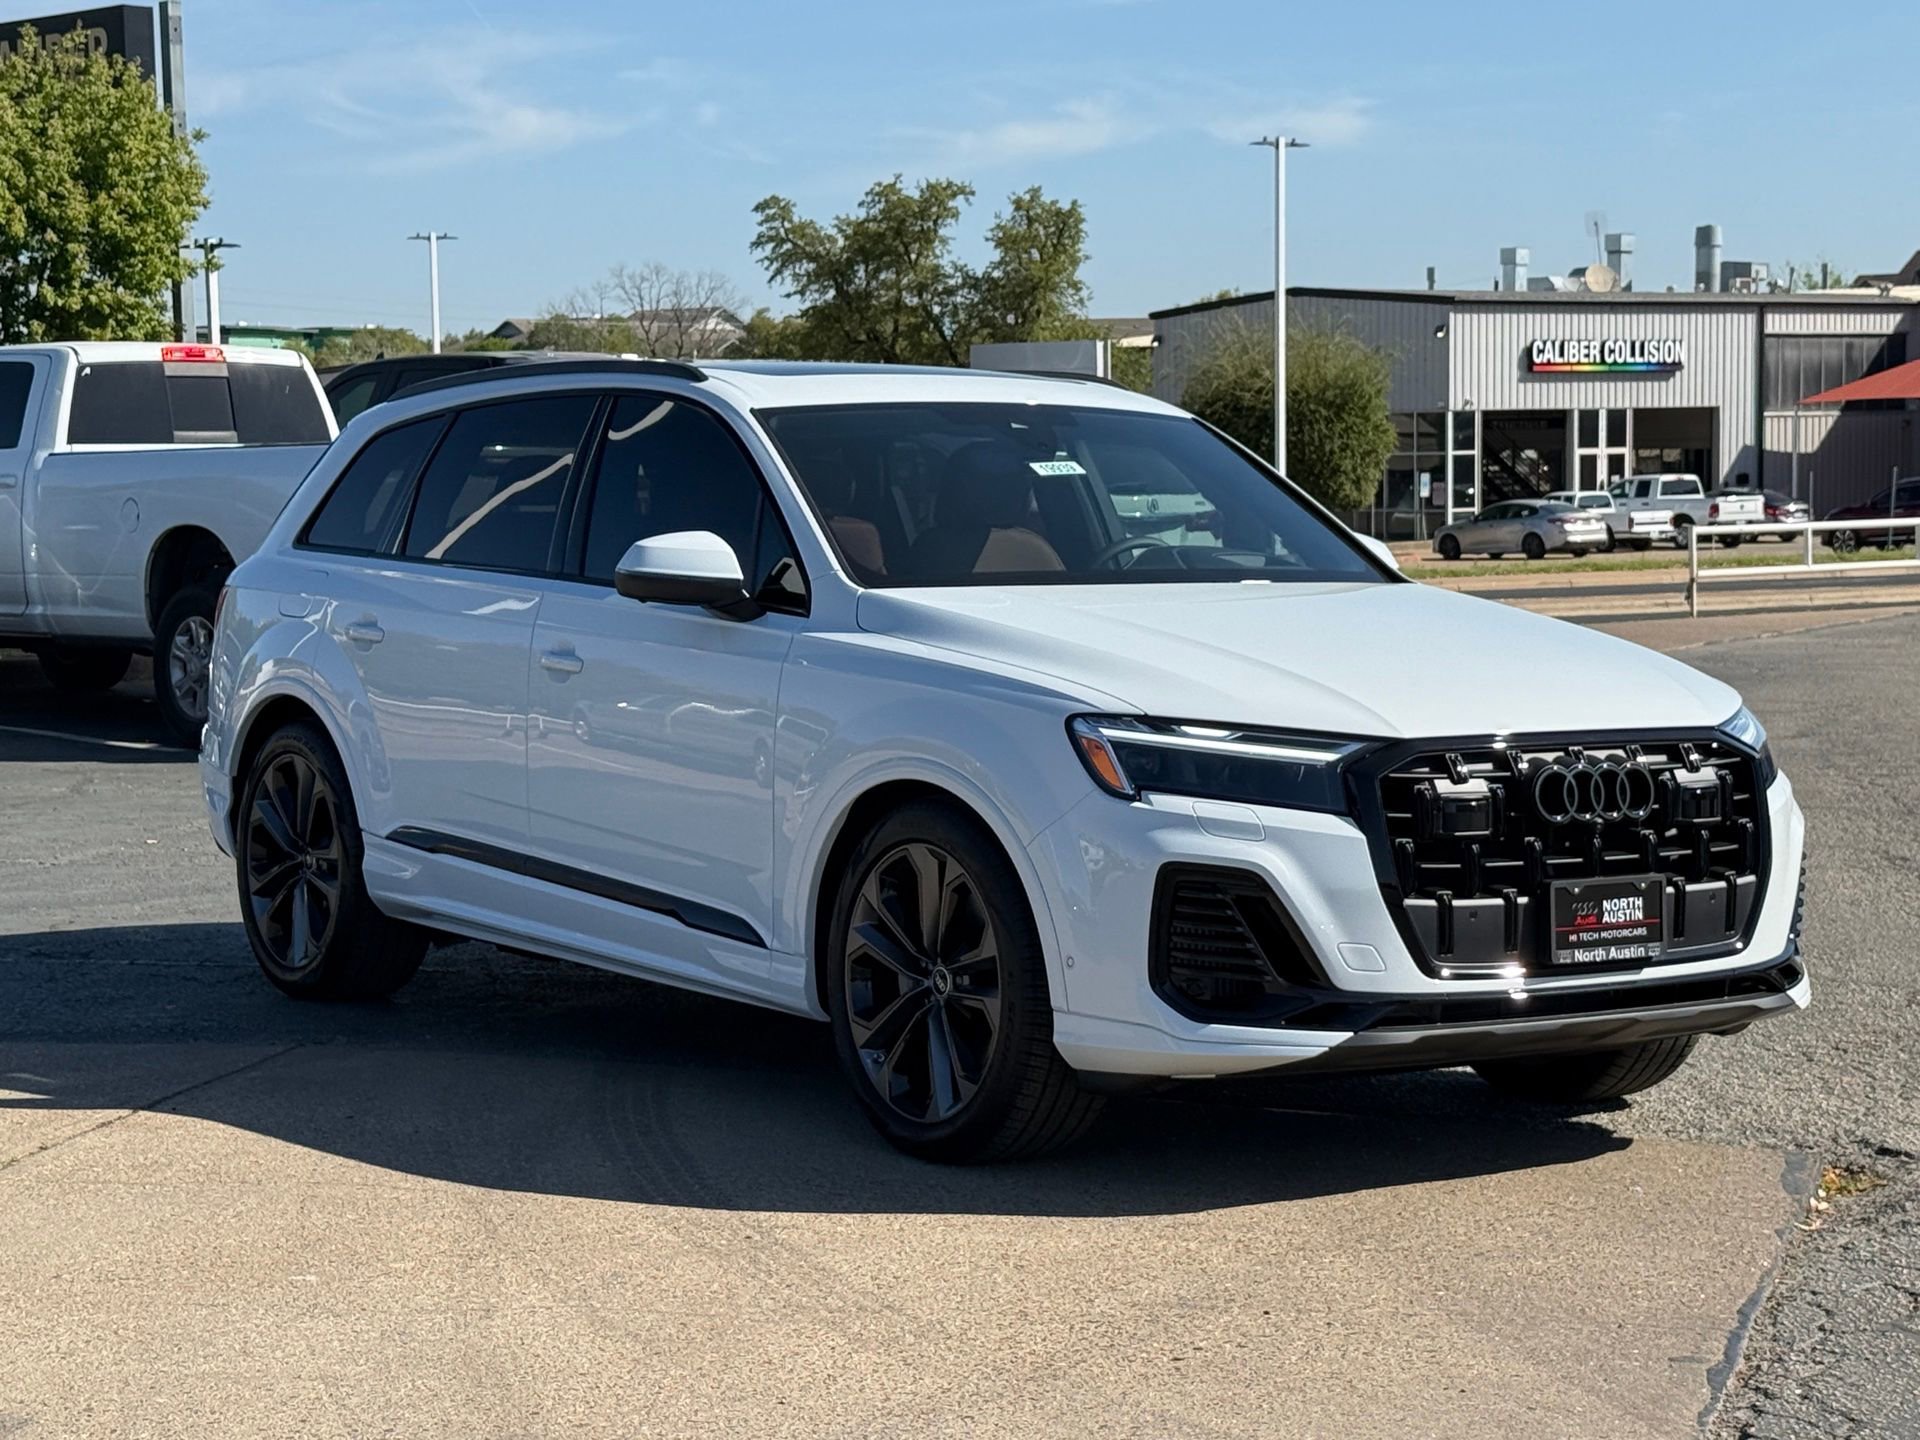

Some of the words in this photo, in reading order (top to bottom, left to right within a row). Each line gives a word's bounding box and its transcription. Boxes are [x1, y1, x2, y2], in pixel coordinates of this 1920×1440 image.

[1532, 340, 1600, 364] CALIBER
[1604, 340, 1685, 364] COLLISION
[1602, 896, 1643, 912] NORTH
[1602, 909, 1643, 924] AUSTIN
[1569, 933, 1578, 943] HI
[1580, 931, 1599, 941] TECH
[1601, 926, 1647, 939] MOTORCARS
[1574, 947, 1606, 962] North
[1609, 945, 1645, 960] Austin
